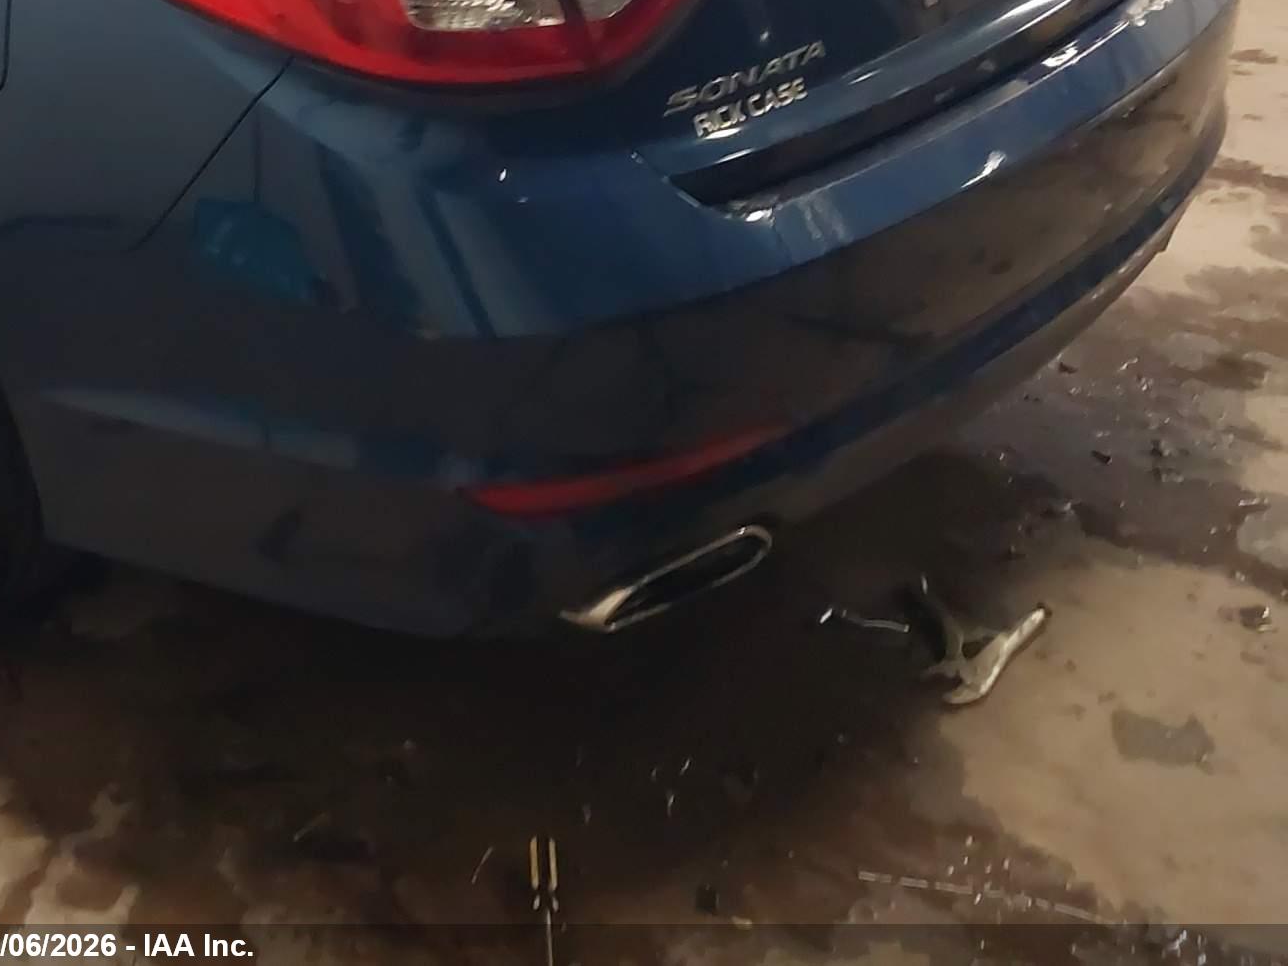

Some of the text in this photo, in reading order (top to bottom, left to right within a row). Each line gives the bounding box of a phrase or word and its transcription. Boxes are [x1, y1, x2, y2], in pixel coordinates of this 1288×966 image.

[663, 40, 827, 117] SONATA
[693, 77, 809, 137] RICK CASE
